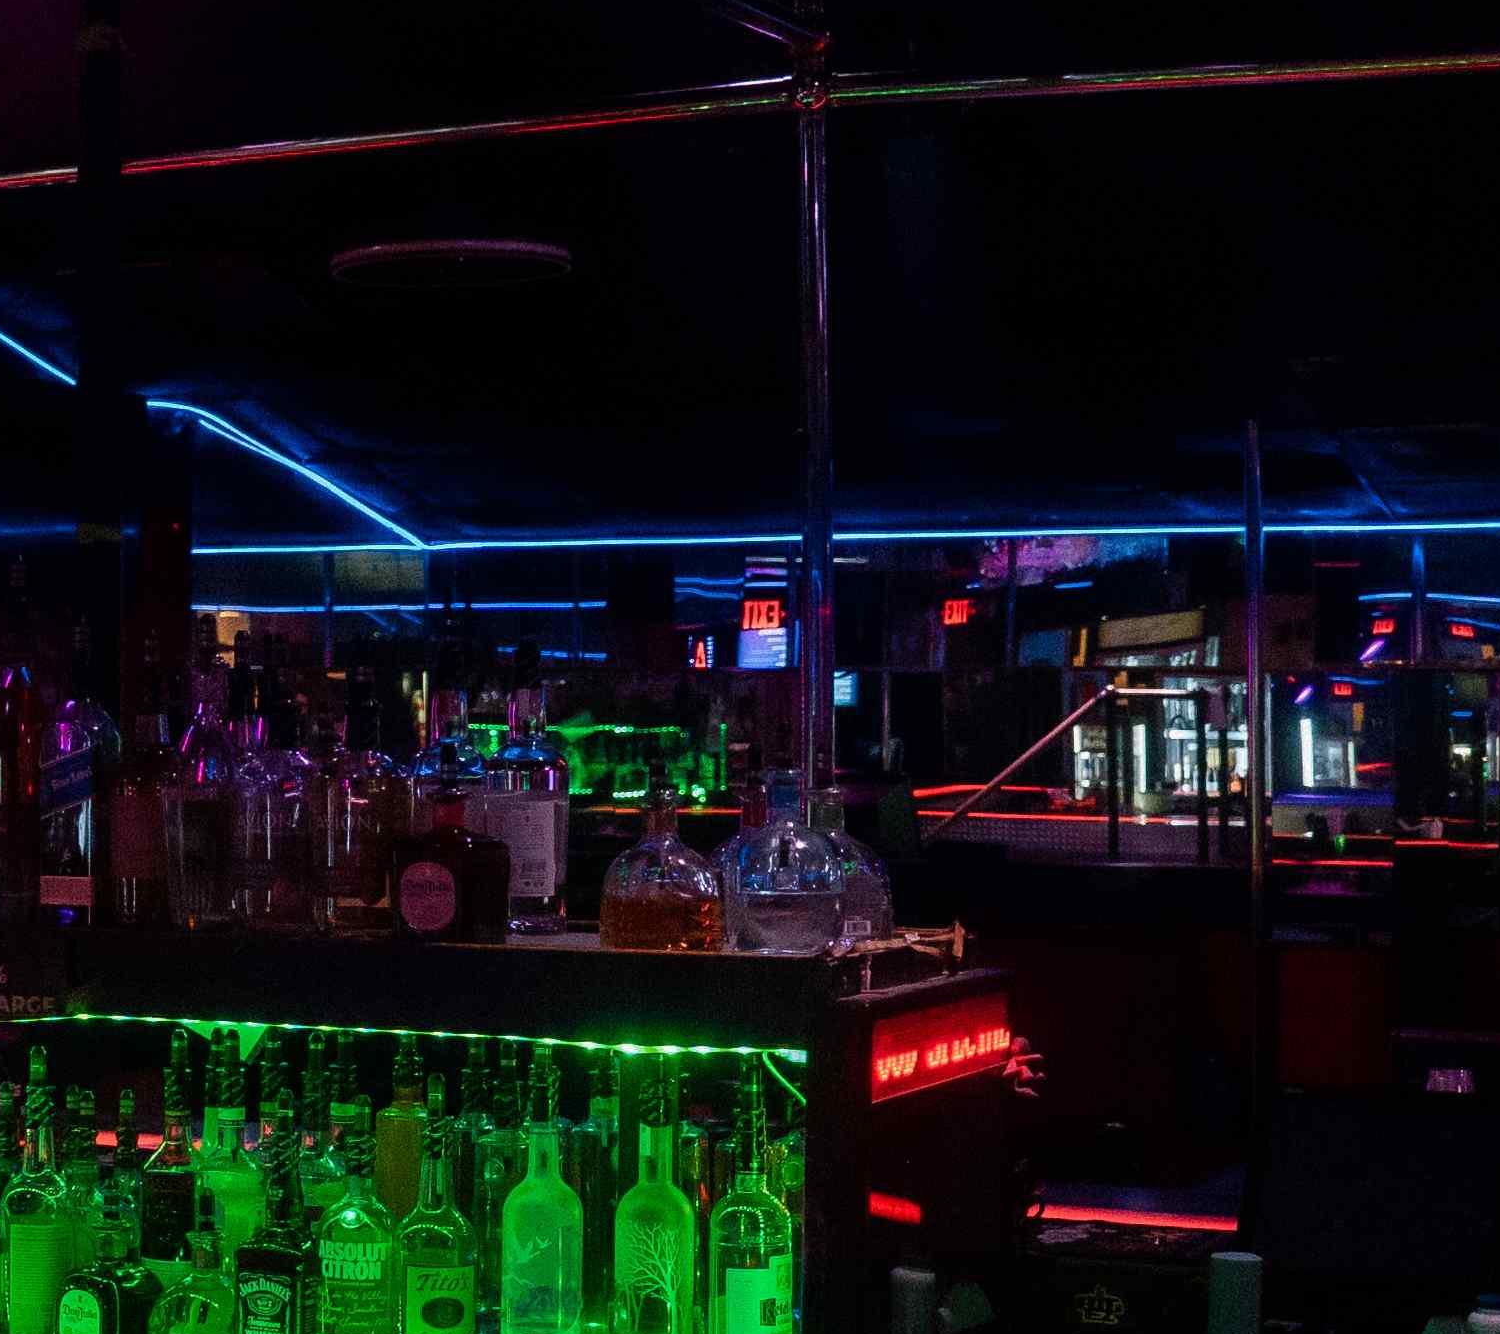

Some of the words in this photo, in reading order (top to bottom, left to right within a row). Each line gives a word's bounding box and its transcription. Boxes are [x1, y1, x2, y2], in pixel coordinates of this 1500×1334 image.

[943, 600, 970, 625] EXIT
[319, 1239, 389, 1262] ABSOLUT
[321, 1259, 382, 1281] CITRON
[239, 1280, 260, 1298] JACK
[258, 1278, 292, 1302] DANIEL'S
[416, 1272, 470, 1292] Tito's
